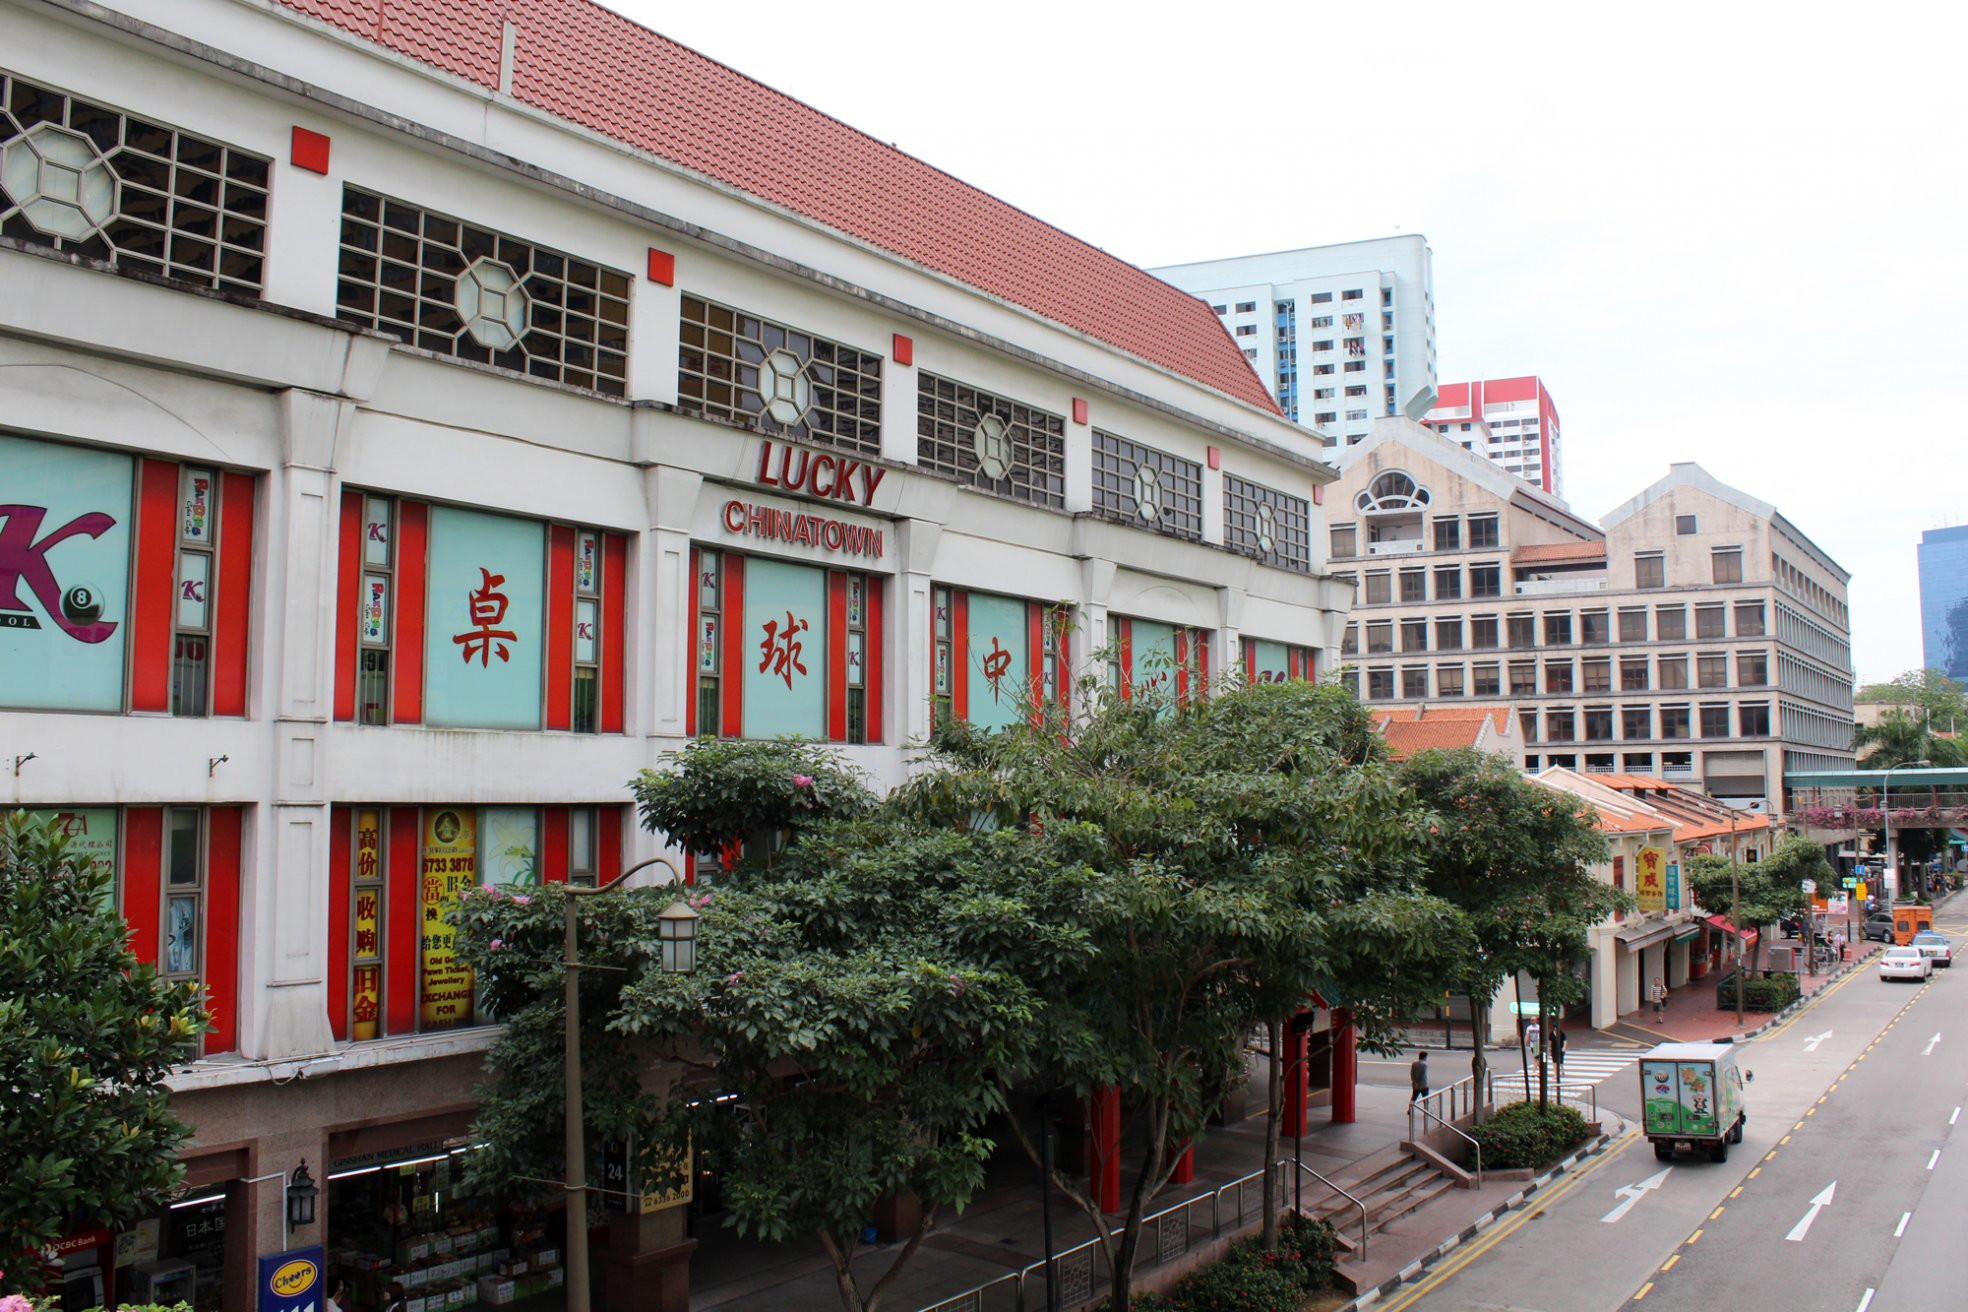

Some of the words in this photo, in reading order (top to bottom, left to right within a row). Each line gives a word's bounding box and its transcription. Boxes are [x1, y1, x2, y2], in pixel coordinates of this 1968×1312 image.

[759, 441, 886, 506] LUCKY
[725, 500, 883, 557] CHINATOWN
[0, 504, 118, 643] K
[76, 590, 88, 604] 8
[181, 580, 204, 603] K
[452, 567, 517, 669] 桌
[759, 610, 808, 690] 球
[983, 636, 1011, 706] 中
[450, 857, 474, 872] 3878
[430, 957, 442, 965] Old
[422, 968, 443, 976] Pawn
[428, 976, 465, 986] Jewellery
[421, 990, 473, 1003] EXCHANGE
[437, 1004, 456, 1016] FOR
[417, 1140, 439, 1152] HALL
[607, 1162, 624, 1181] 24
[53, 1240, 77, 1251] OCBC
[77, 1234, 97, 1246] Bank
[275, 1266, 312, 1289] Cheers
